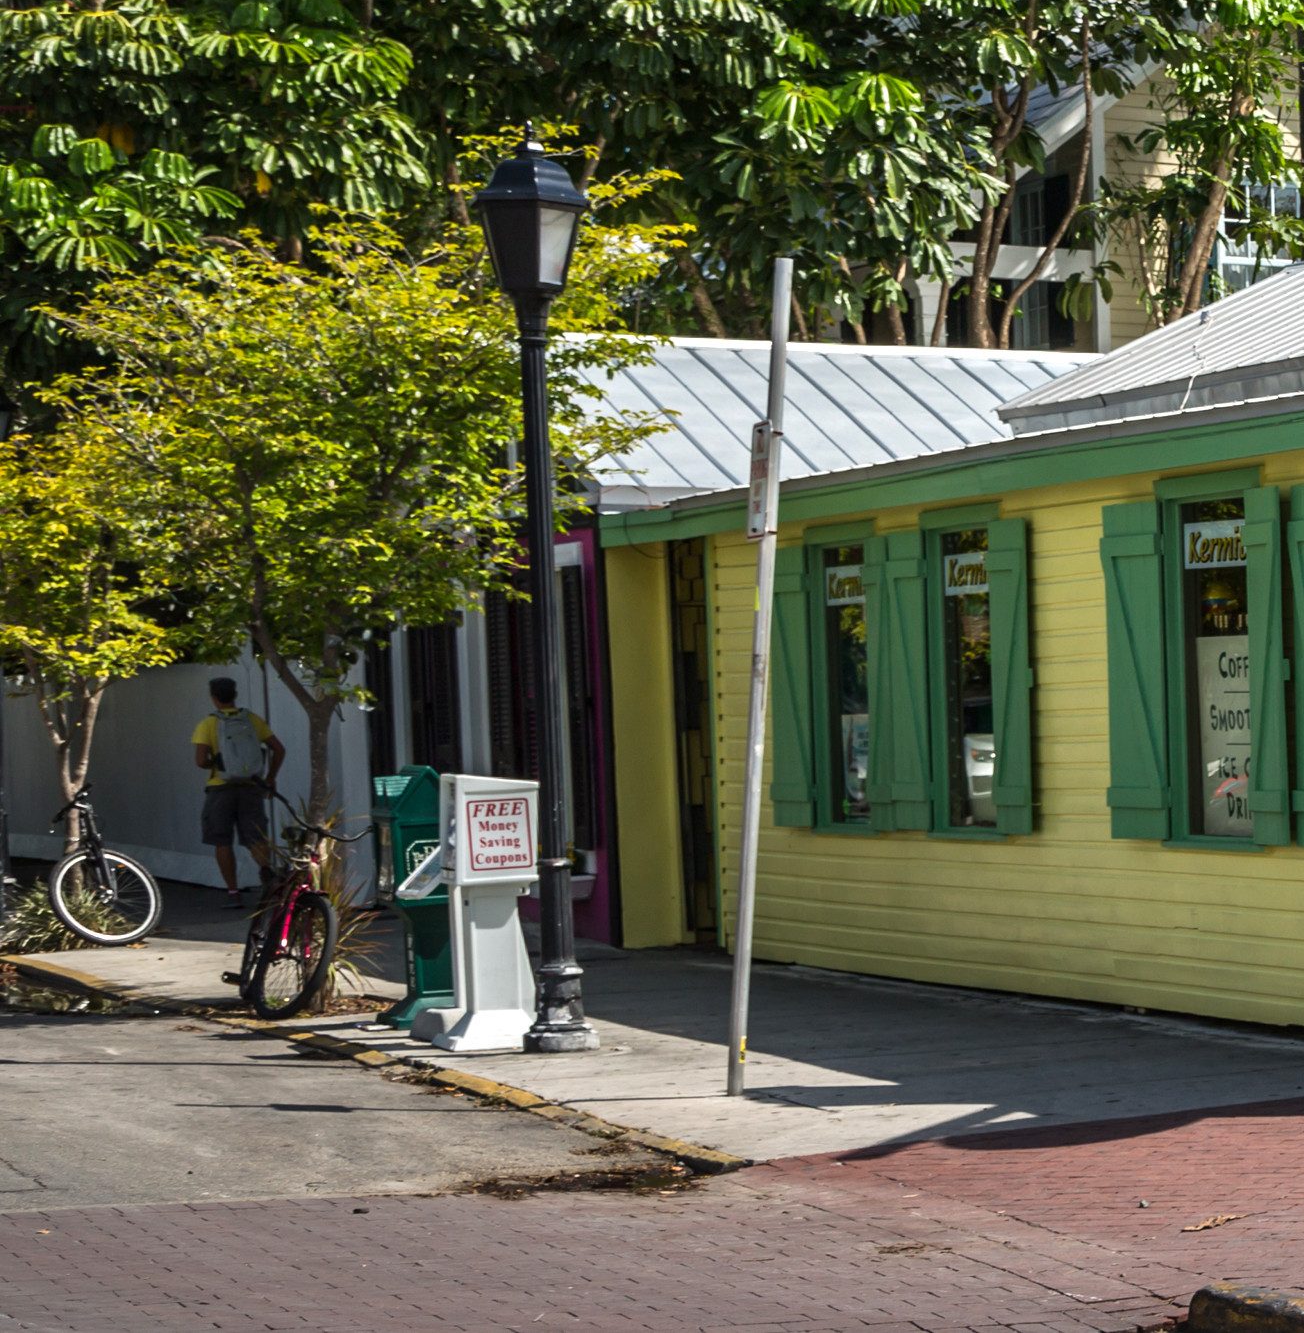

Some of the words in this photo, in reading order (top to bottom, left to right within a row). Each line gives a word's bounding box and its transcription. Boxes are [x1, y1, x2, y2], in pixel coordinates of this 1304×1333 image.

[1218, 652, 1248, 679] COFF
[1210, 704, 1250, 733] SMOOT
[473, 802, 523, 817] FREE
[1227, 791, 1252, 819] DRI
[478, 820, 518, 833] Money
[480, 836, 521, 848] Saving
[475, 853, 528, 866] Coupons
